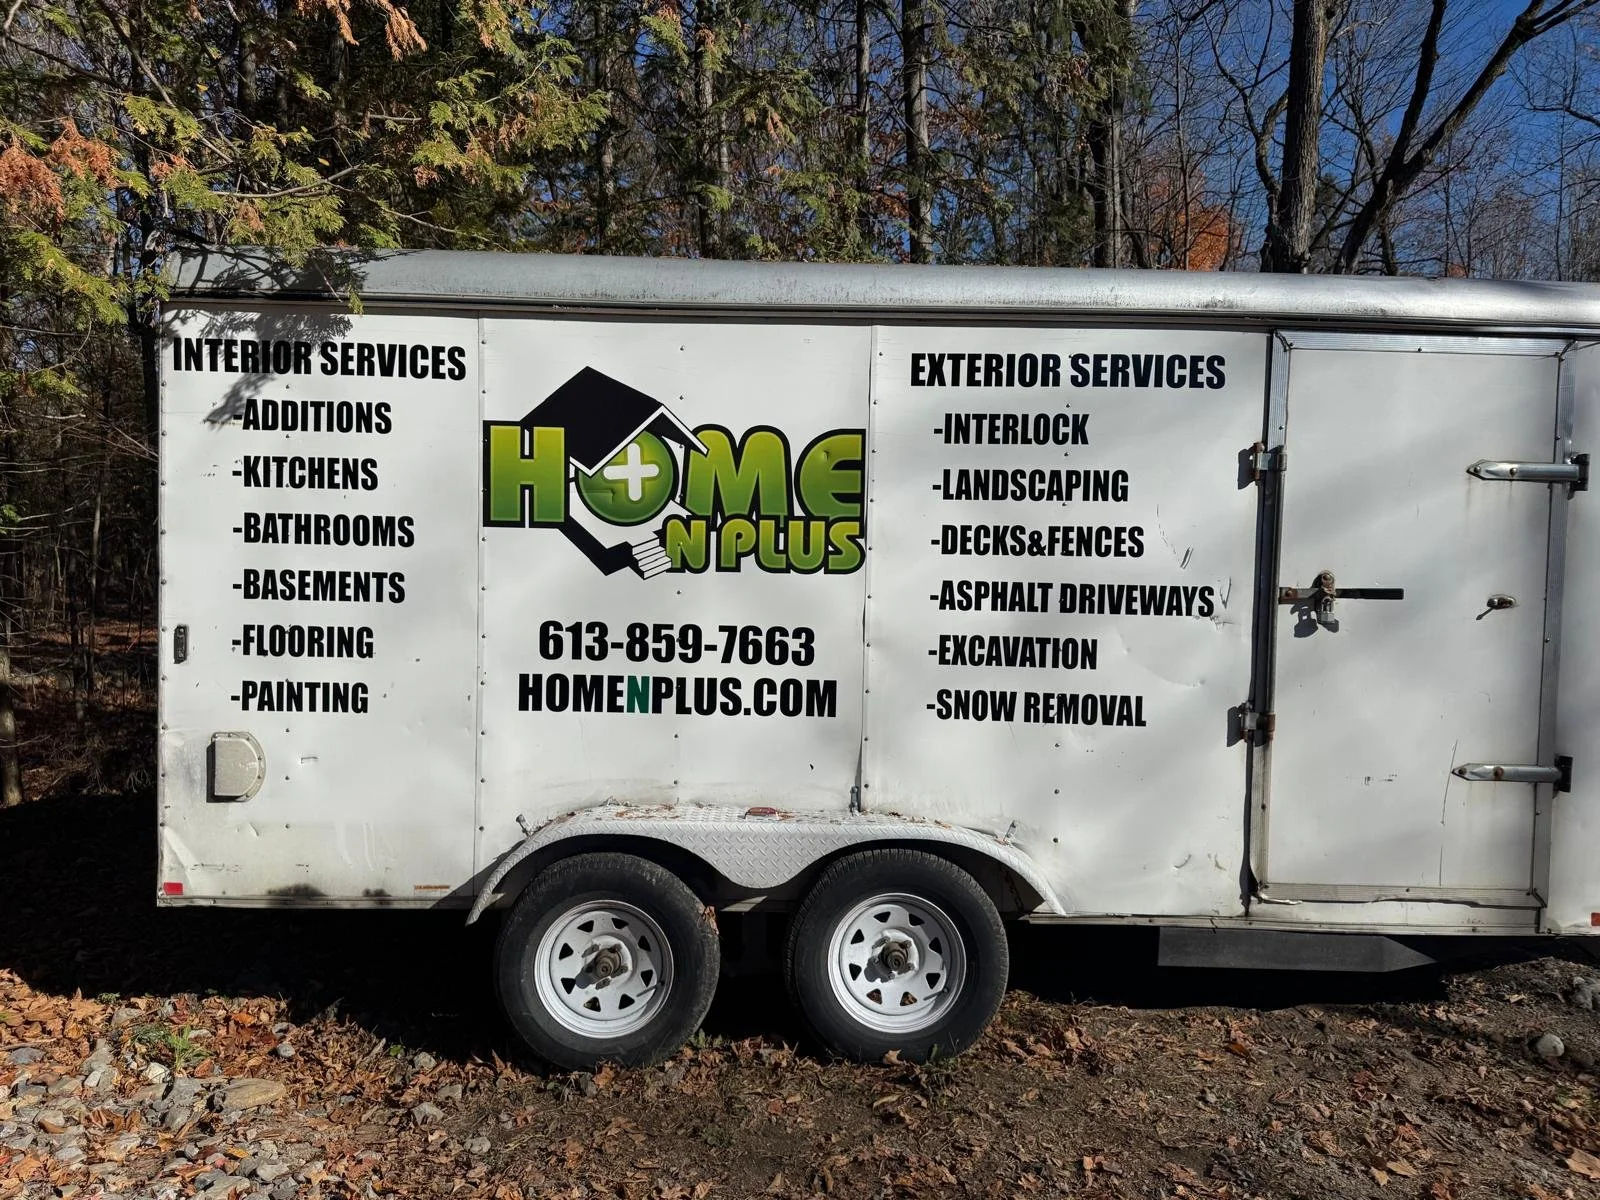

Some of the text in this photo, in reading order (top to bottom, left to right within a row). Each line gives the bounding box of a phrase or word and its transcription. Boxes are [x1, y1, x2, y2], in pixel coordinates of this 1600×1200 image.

[173, 337, 466, 381] INTERIOR SERVICES
[911, 353, 1226, 389] EXTERIOR SERVICES
[233, 399, 392, 434] -ADDITIONS
[933, 413, 1090, 445] -INTERLOCK
[232, 455, 378, 491] -KITCHENS
[932, 469, 1129, 502] -LANDSCAPING
[232, 512, 415, 547] -BATHROOMS
[930, 524, 1145, 558] -DECKS&FENCES
[232, 568, 406, 603] -BASEMENTS
[929, 580, 1215, 617] -ASPHALT DRIVEWAYS
[232, 624, 374, 658] -FLOORING
[538, 620, 816, 666] 613-859-7663
[928, 634, 1098, 670] -EXCAVATION
[230, 680, 368, 713] -PAINTING
[518, 673, 837, 718] HOMENPLUS.COM
[926, 689, 1147, 727] -SNOW REMOVAL
